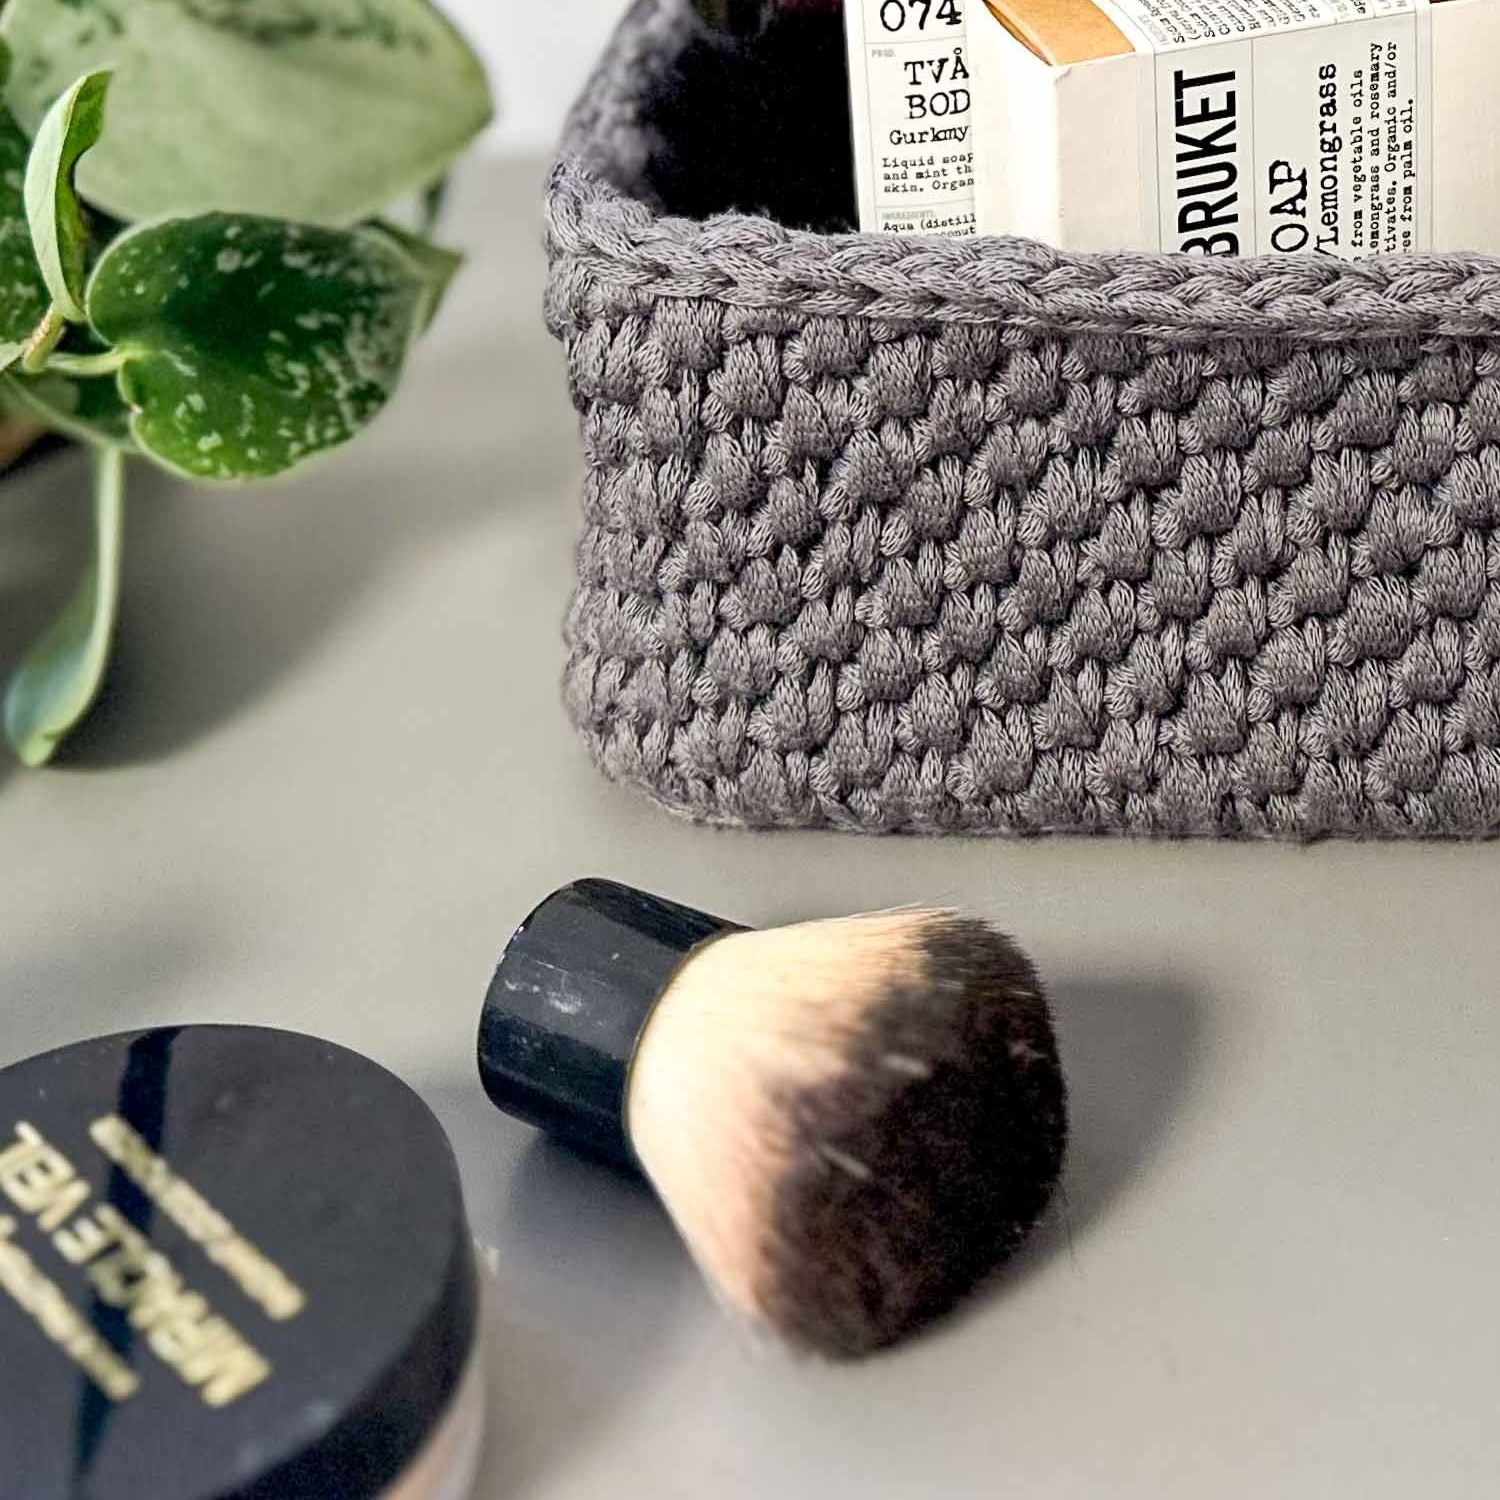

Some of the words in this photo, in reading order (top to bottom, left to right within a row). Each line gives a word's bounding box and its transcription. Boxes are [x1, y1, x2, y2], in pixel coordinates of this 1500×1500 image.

[904, 47, 970, 86] TVÅ
[1368, 42, 1382, 120] rosemary
[1384, 41, 1397, 99] and/or
[904, 89, 971, 119] BOD
[1350, 69, 1364, 108] oils
[1400, 98, 1413, 134] oil.
[1368, 128, 1380, 157] and
[1384, 107, 1400, 172] Organic
[881, 155, 935, 170] Liquid
[883, 170, 909, 181] and
[915, 168, 948, 179] mint
[1173, 69, 1239, 256] BRUKET
[1350, 116, 1366, 203] vegetable
[1400, 140, 1415, 179] palm
[1267, 160, 1310, 253] OAP
[1400, 186, 1412, 223] from
[883, 222, 914, 232] Aqua
[1350, 209, 1363, 248] from
